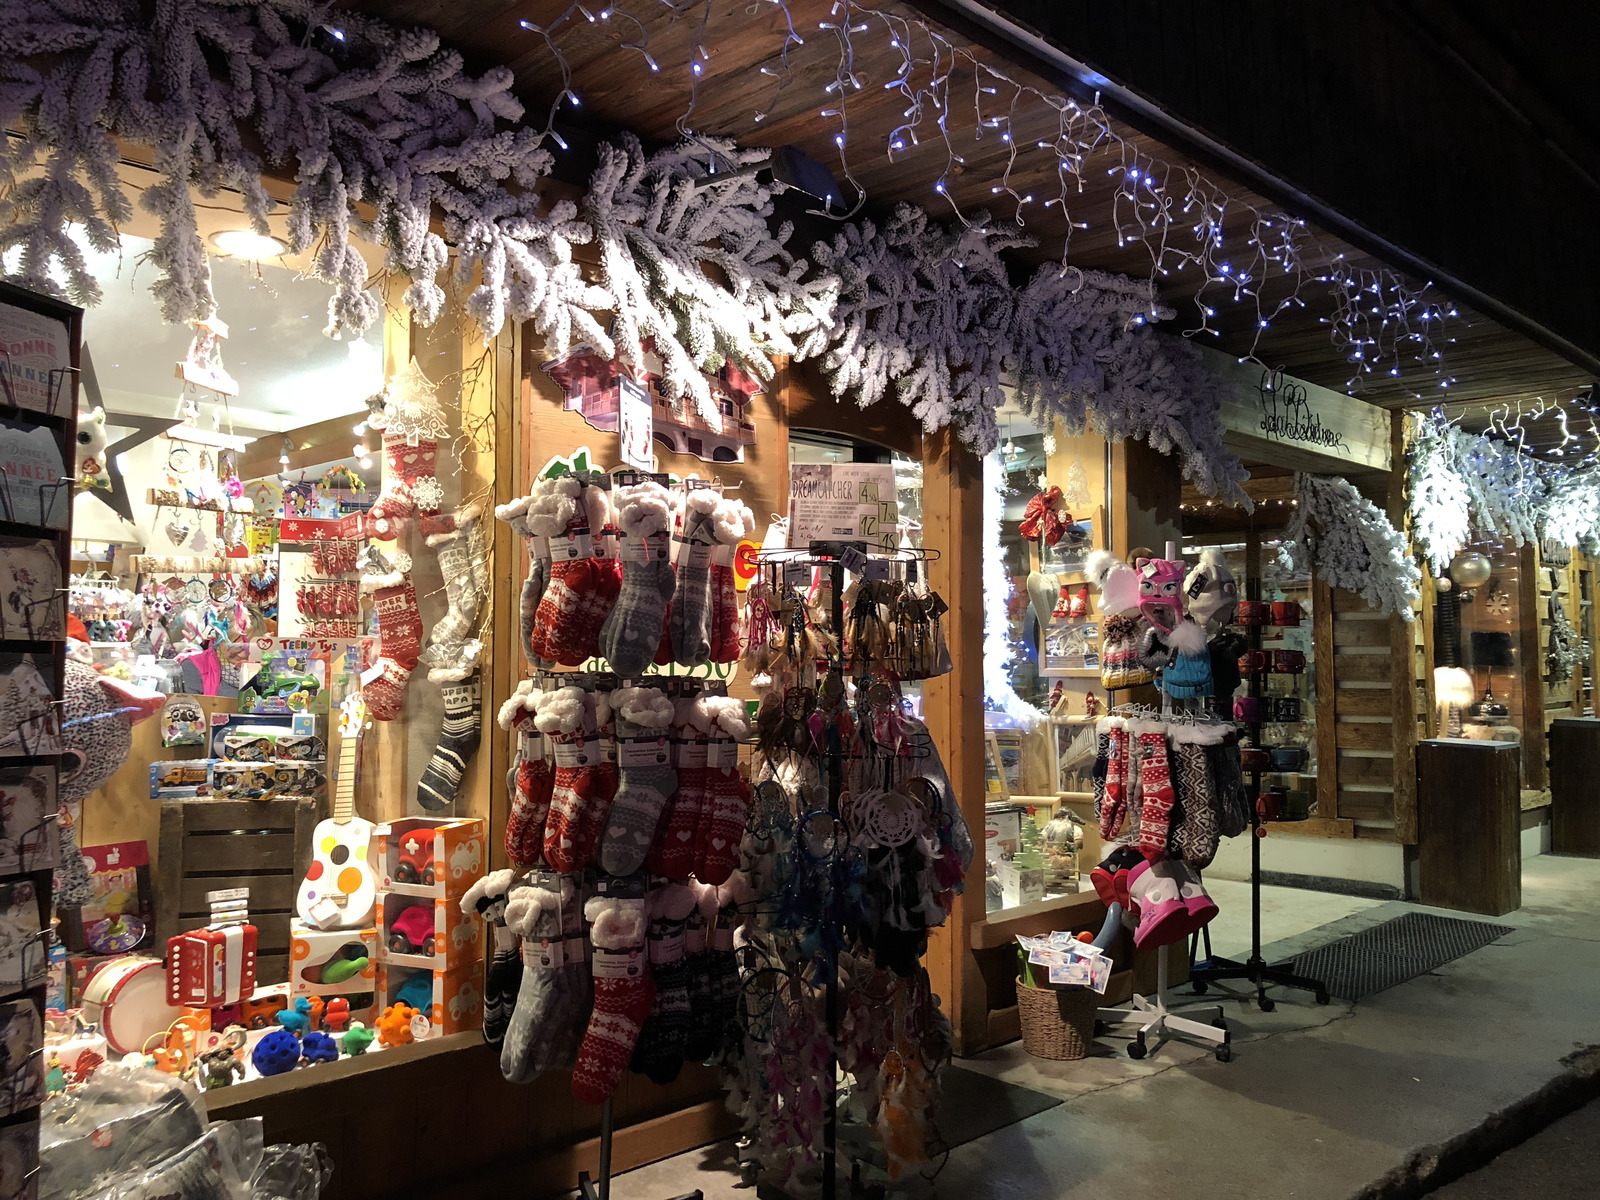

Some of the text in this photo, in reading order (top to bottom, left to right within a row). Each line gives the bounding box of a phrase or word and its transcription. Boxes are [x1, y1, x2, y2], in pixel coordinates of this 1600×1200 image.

[792, 480, 853, 500] DREAMCATCHER
[279, 639, 316, 651] TEENY
[669, 658, 732, 680] 150
